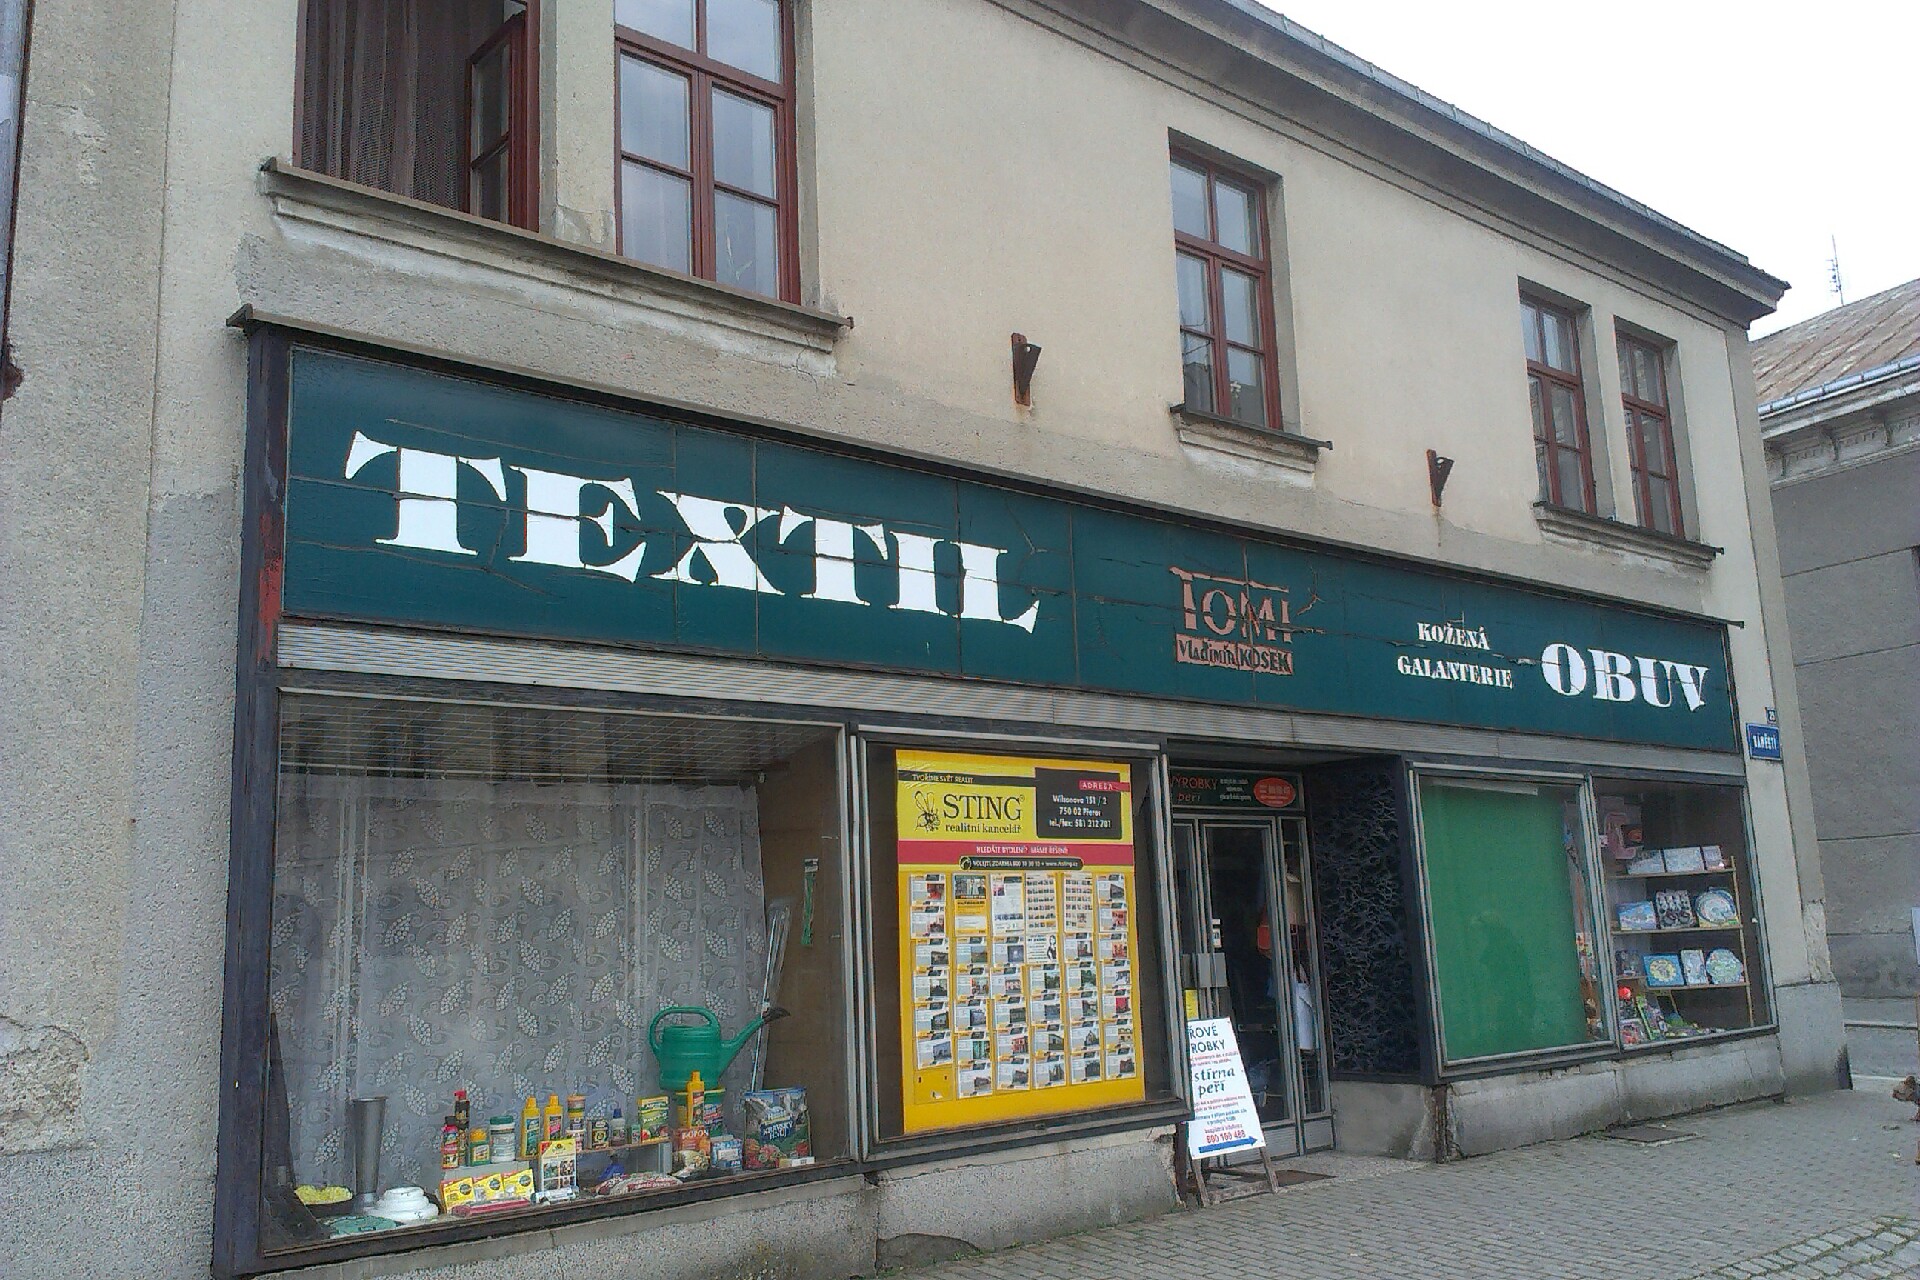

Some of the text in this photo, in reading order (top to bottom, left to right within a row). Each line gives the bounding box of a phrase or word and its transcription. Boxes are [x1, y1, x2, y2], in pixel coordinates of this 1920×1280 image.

[344, 430, 1041, 634] TEXTIL
[1169, 566, 1292, 644] TOMI
[1417, 622, 1490, 650] KOŽENÁ
[1240, 647, 1292, 674] KOSEK
[1397, 655, 1513, 690] GALANTERIE
[1541, 643, 1710, 712] OBUV
[1082, 782, 1114, 791] ADRESA
[943, 793, 1021, 820] STING
[1059, 807, 1072, 816] 750
[1073, 807, 1082, 816] 02
[945, 822, 1021, 834] realitní kancelář
[1198, 1080, 1225, 1099] peří
